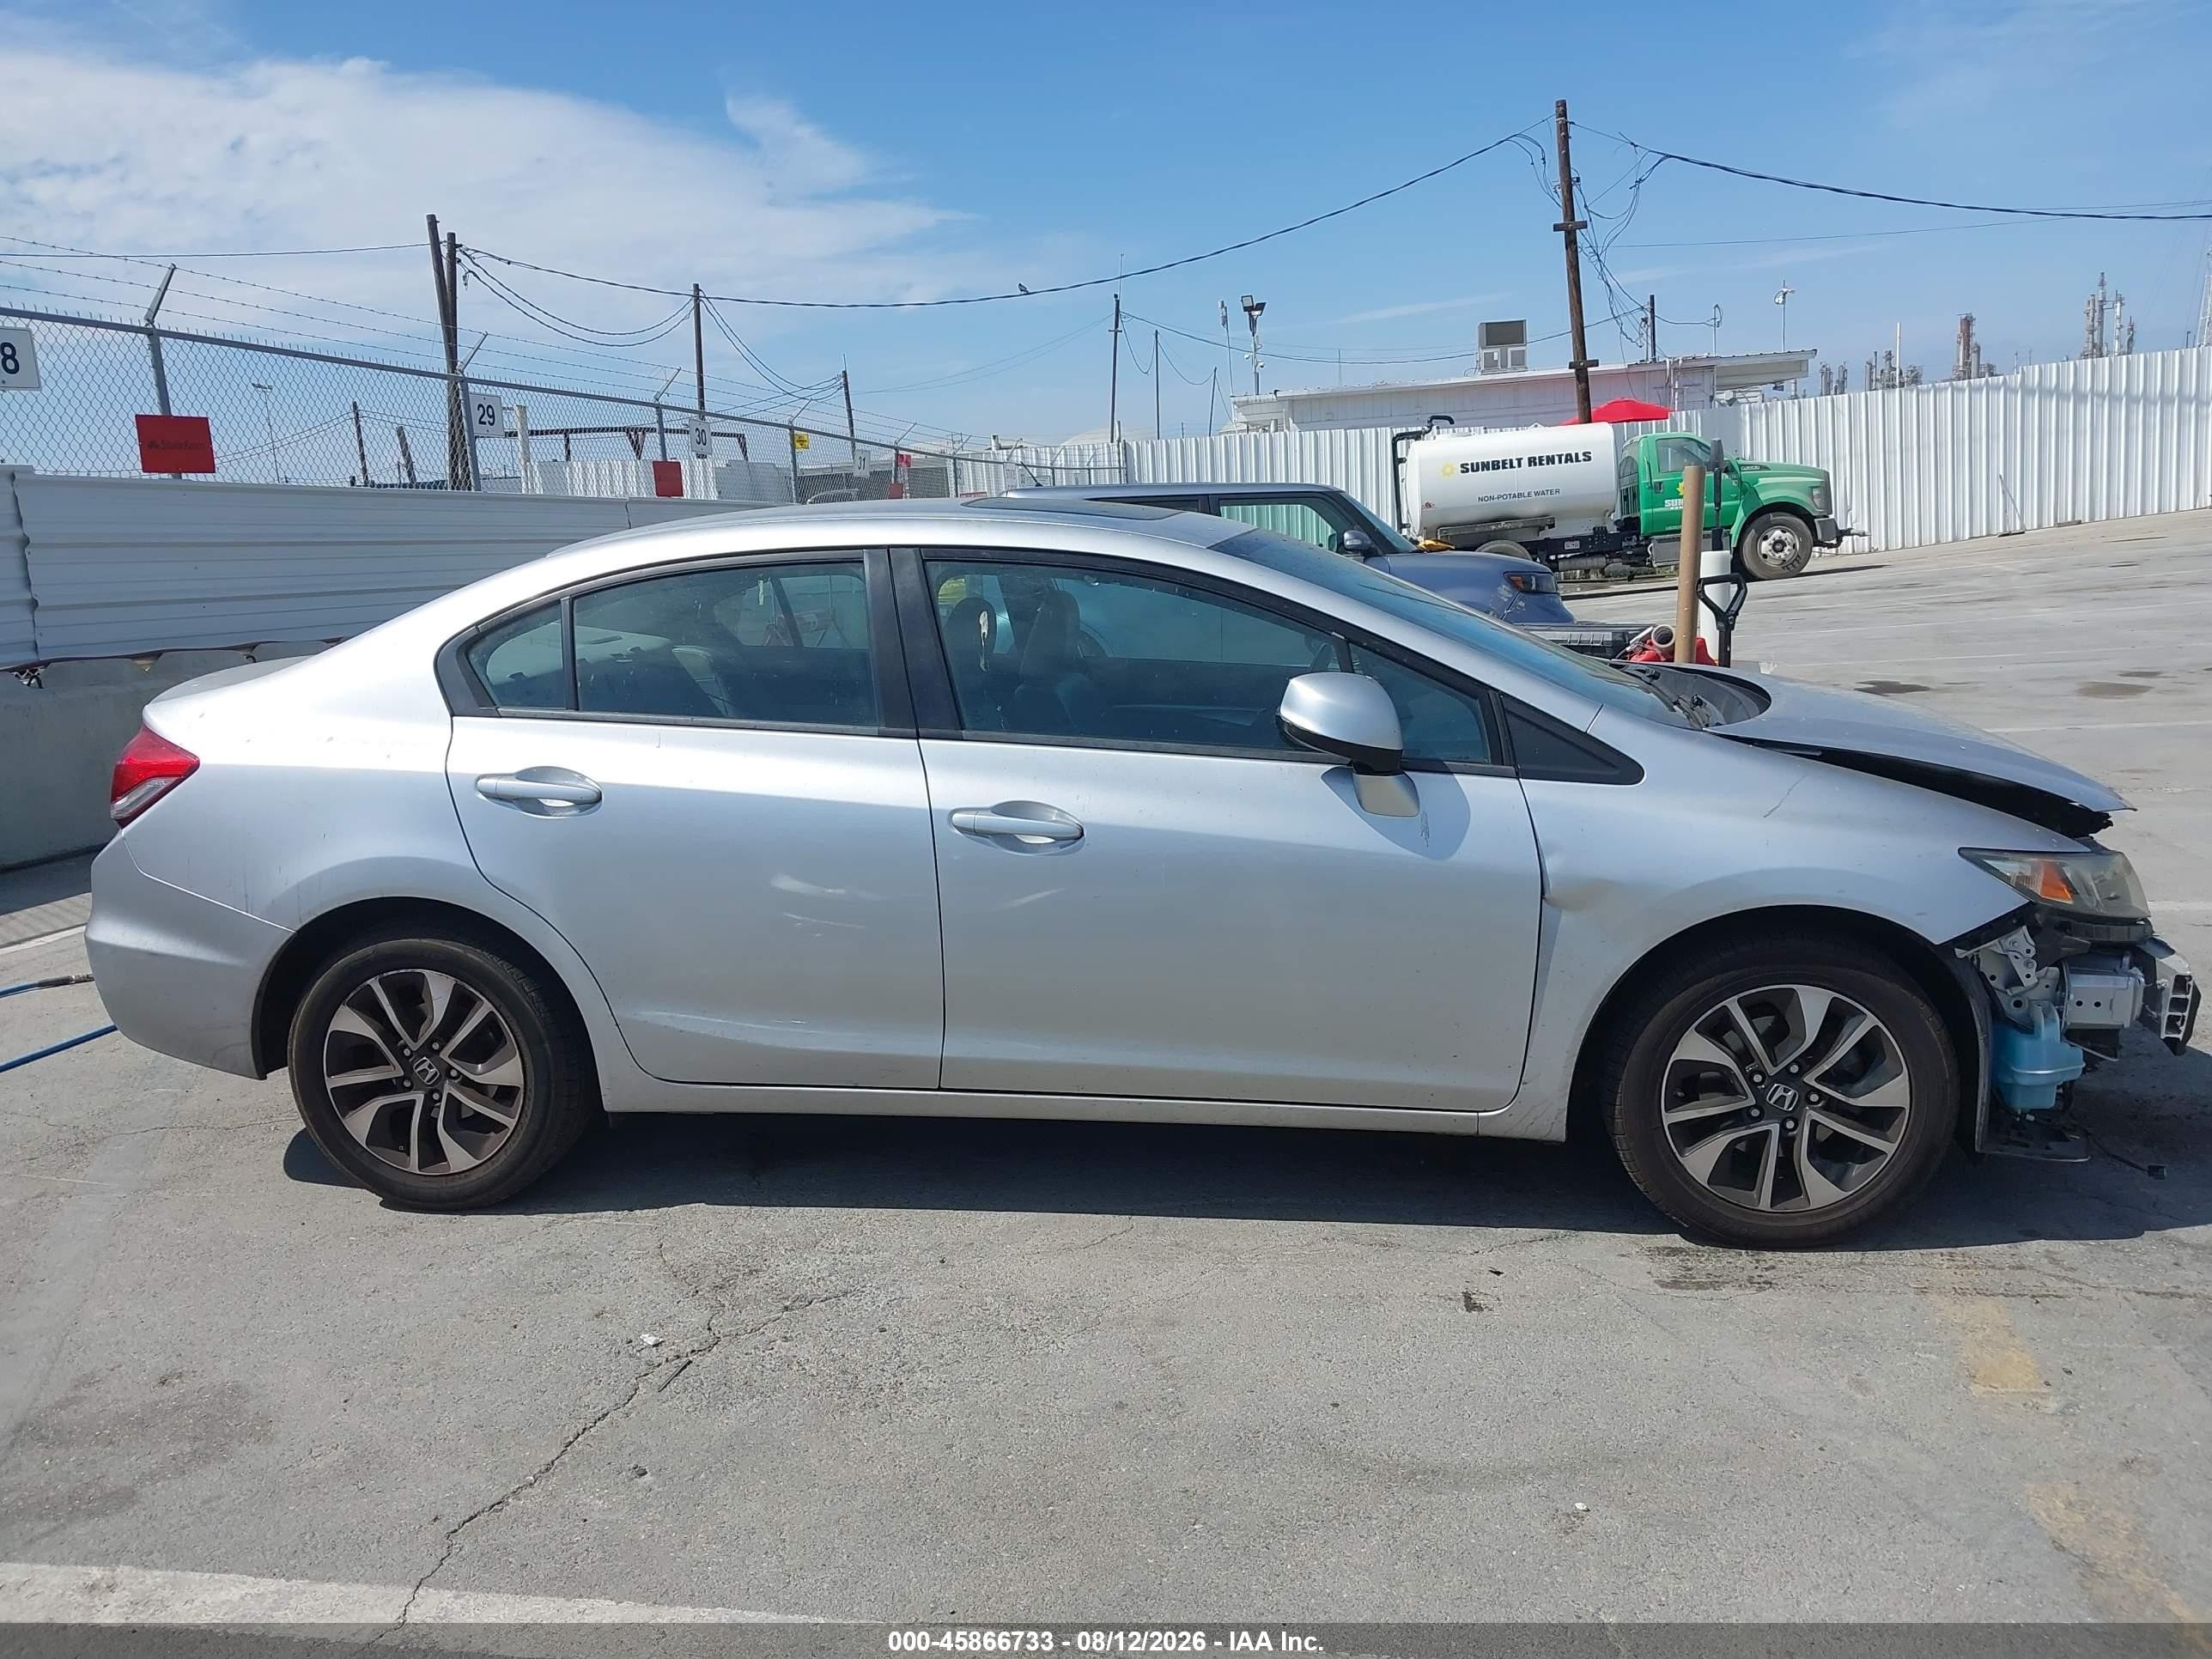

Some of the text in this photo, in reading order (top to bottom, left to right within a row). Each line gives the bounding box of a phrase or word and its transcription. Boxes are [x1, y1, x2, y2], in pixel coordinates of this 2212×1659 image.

[477, 404, 495, 426] 29
[695, 427, 707, 446] 30
[858, 456, 866, 471] 31
[1460, 451, 1592, 474] SUNBELT RENTALS
[1478, 489, 1560, 502] NON-POTABLE WATER
